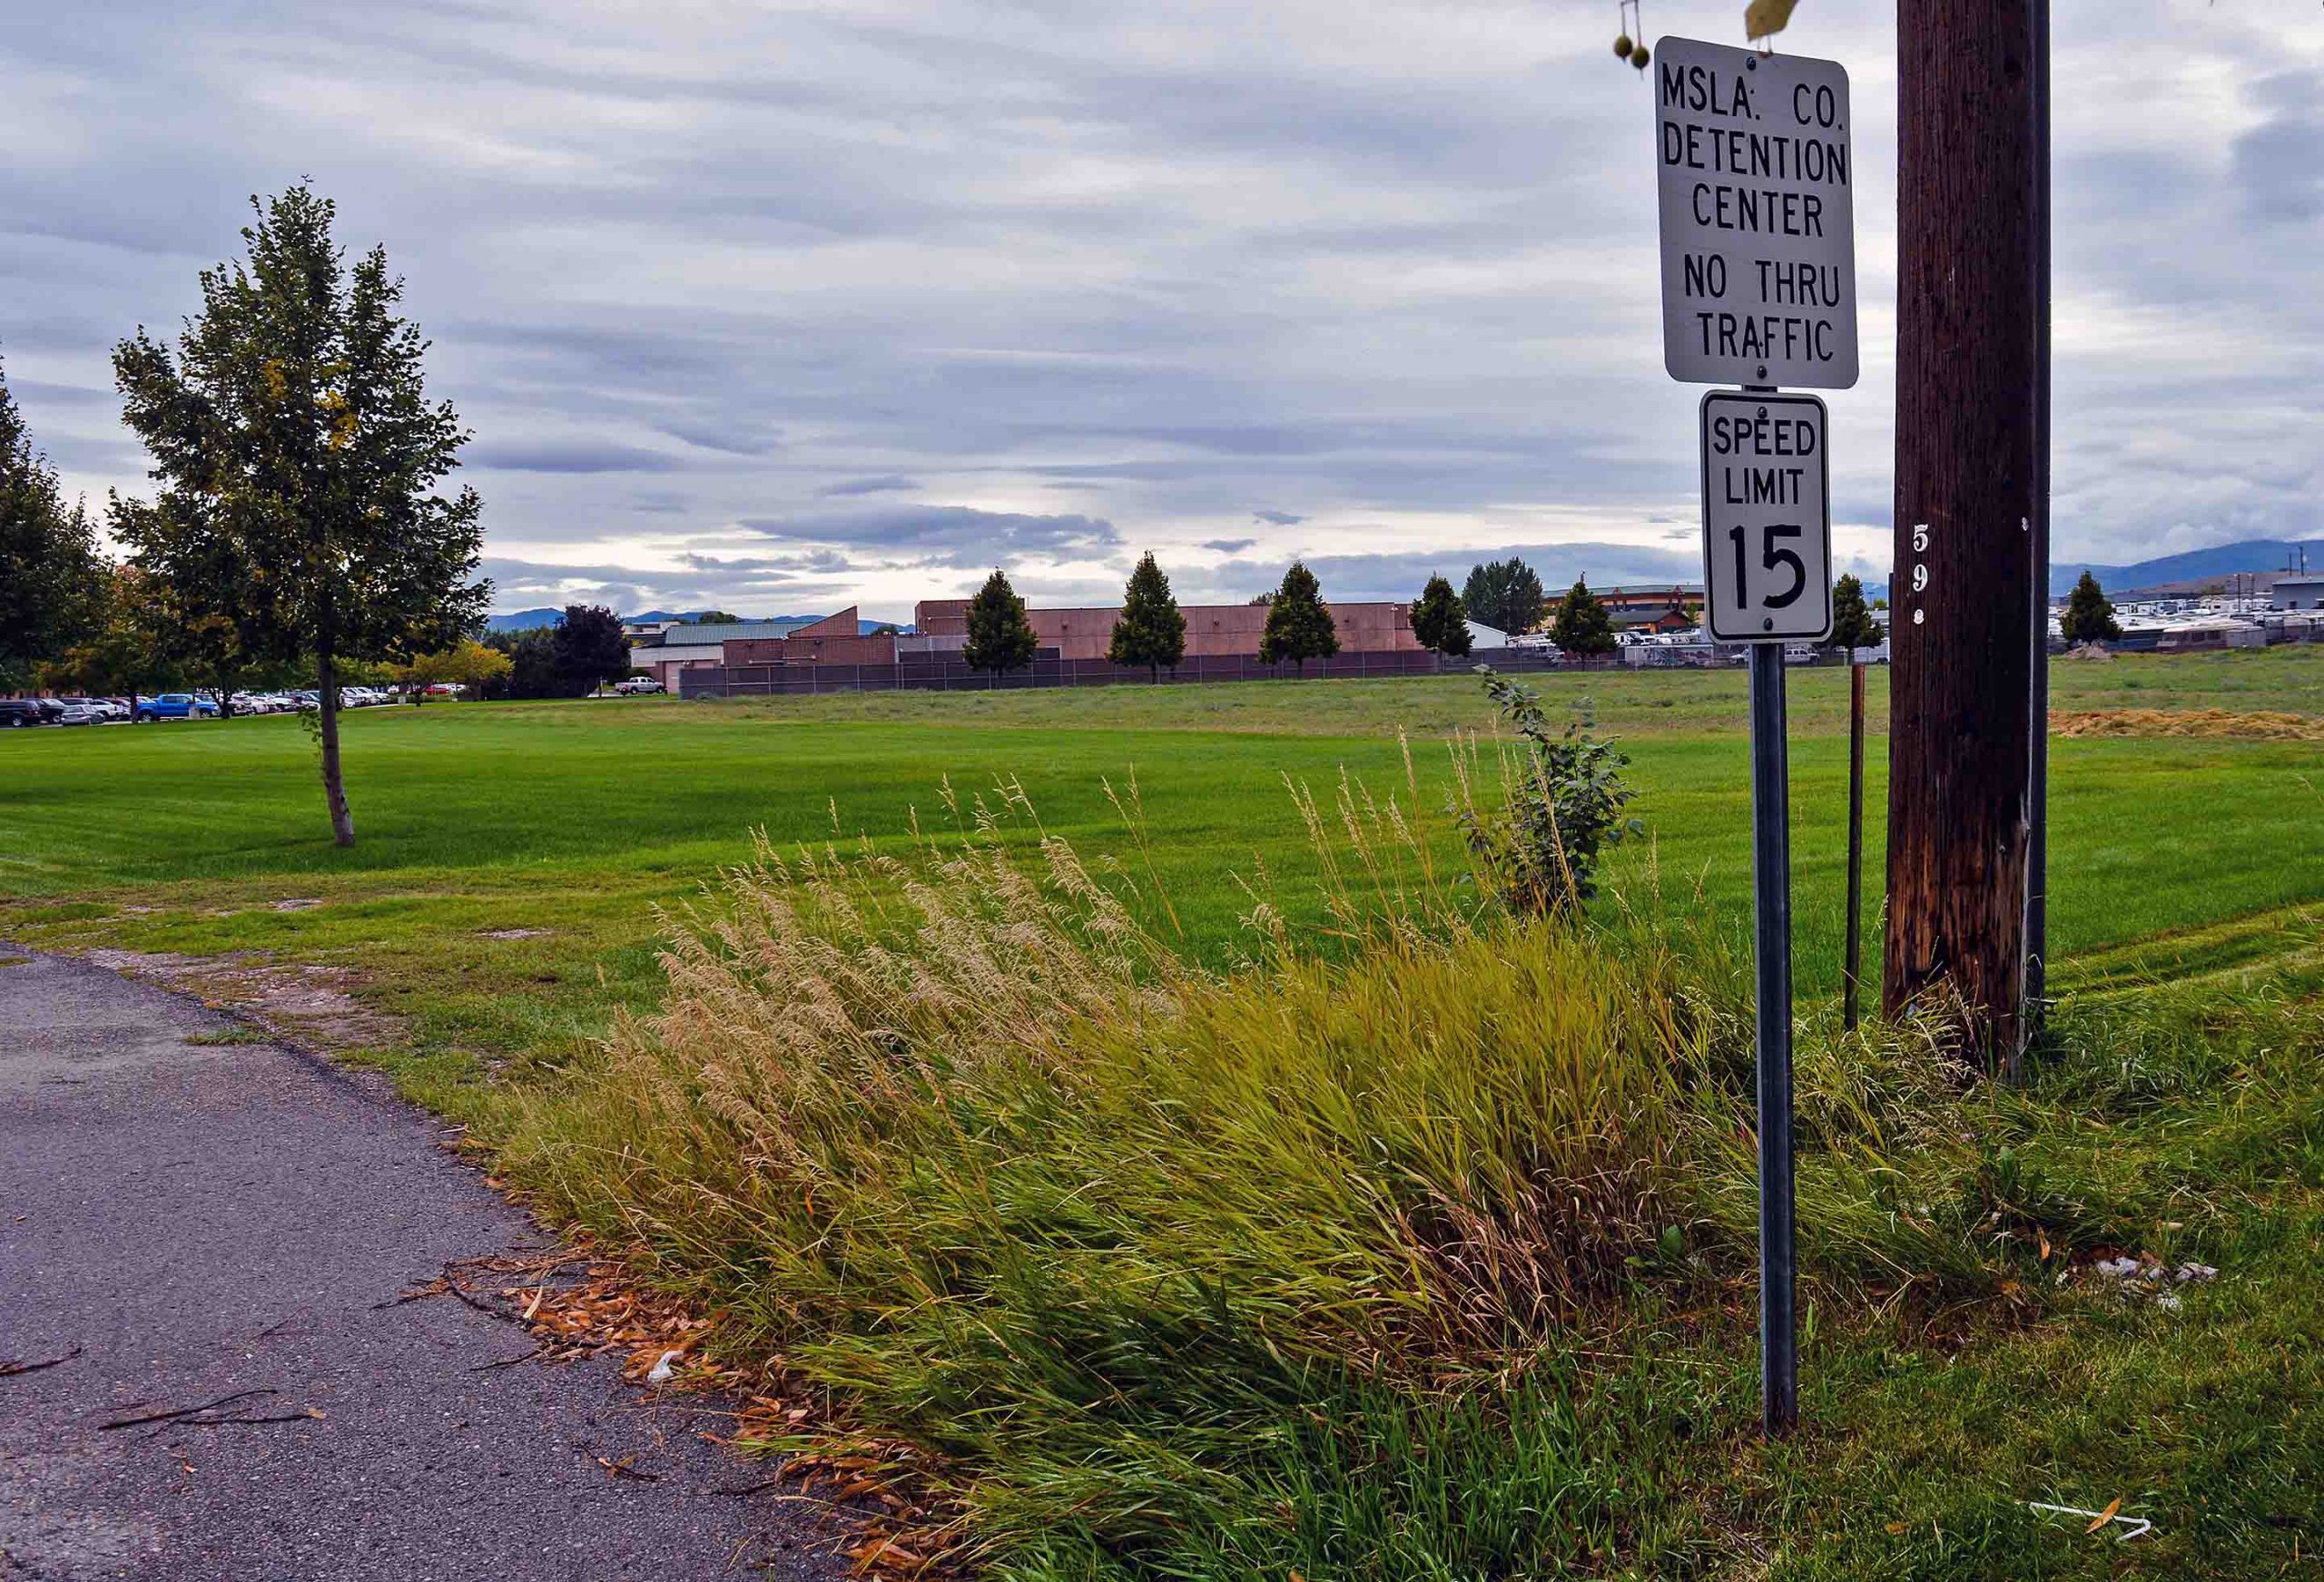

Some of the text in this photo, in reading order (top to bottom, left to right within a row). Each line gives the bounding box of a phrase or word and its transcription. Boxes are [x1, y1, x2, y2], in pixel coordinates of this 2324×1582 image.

[1792, 83, 1844, 131] CO.
[1663, 121, 1847, 185] DETENTION
[1692, 183, 1823, 238] CENTER
[1684, 254, 1840, 308] NO THRU
[1697, 312, 1834, 362] TRAFFIC
[1713, 417, 1816, 457] SPEED
[1725, 467, 1805, 505] LIMIT
[1729, 524, 1807, 610] 15
